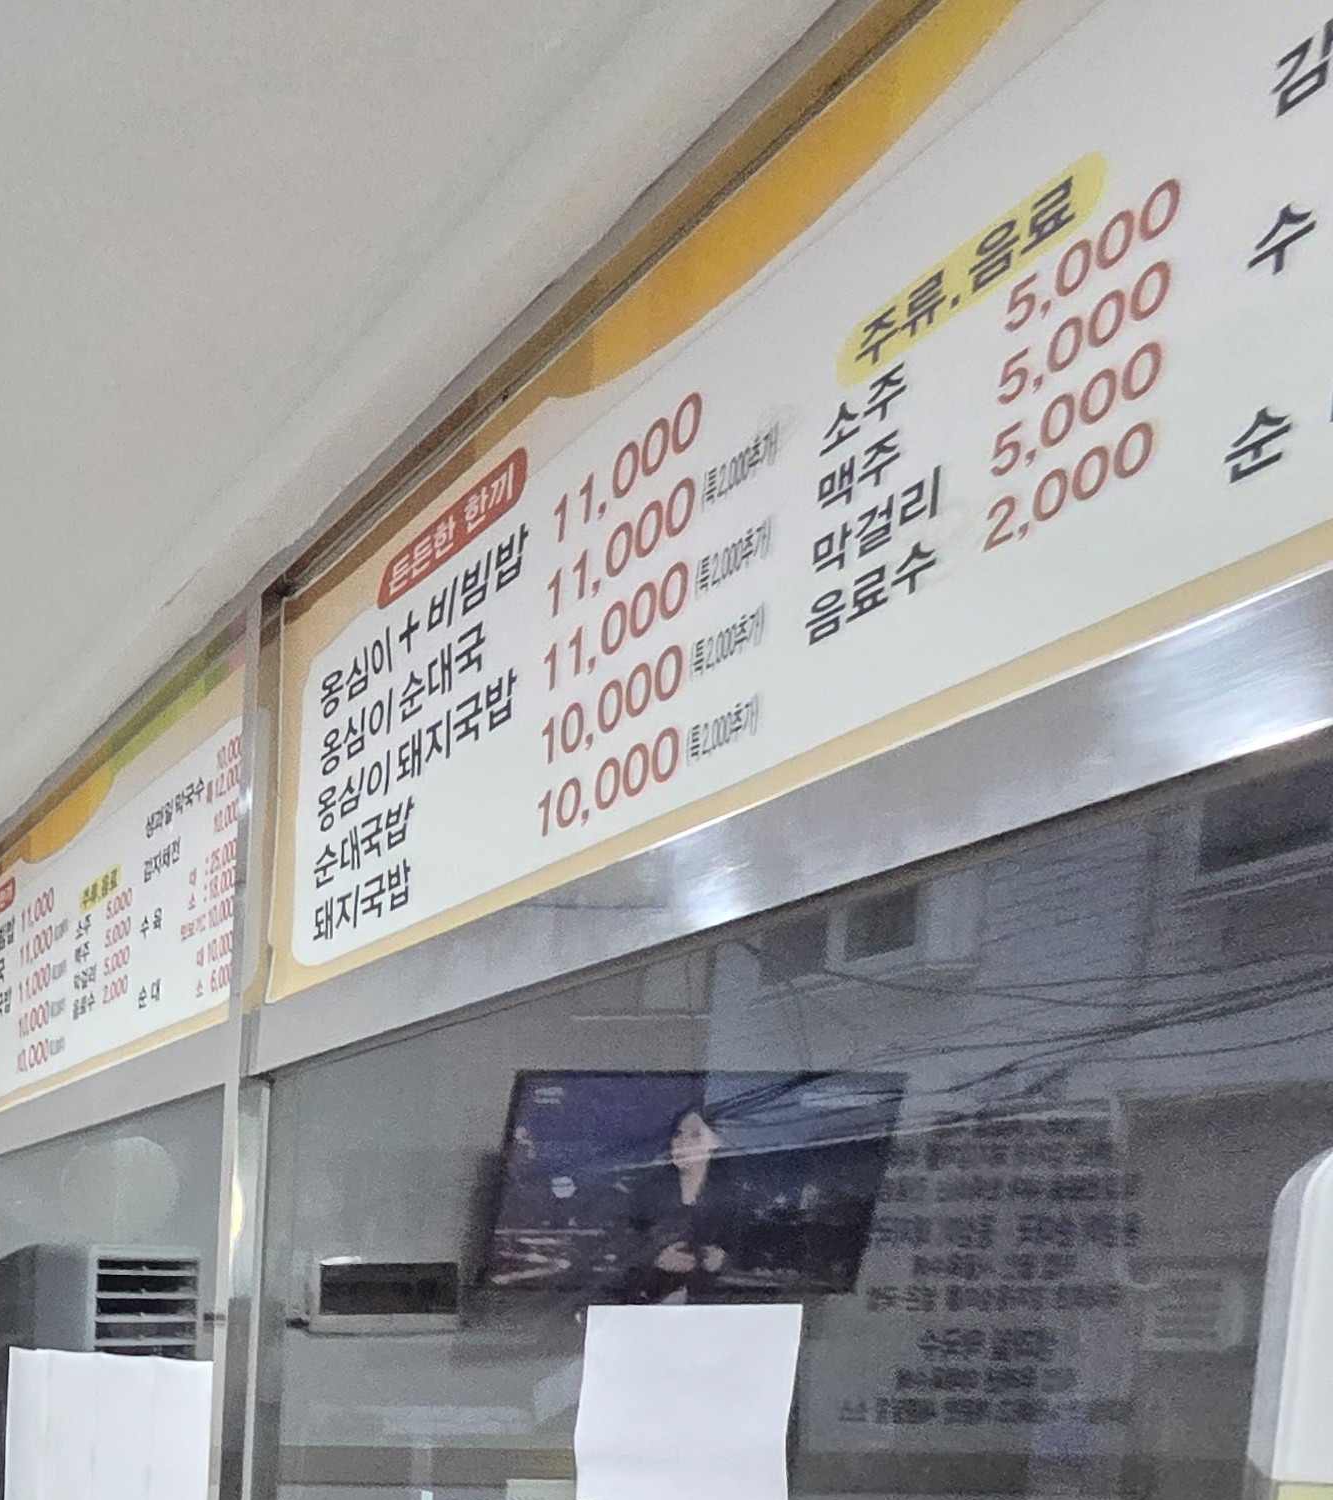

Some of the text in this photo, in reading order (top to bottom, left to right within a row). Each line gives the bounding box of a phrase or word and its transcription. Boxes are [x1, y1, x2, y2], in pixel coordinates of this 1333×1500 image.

[819, 178, 1182, 457] 소주 5,000
[968, 176, 1076, 293] 음료
[1247, 203, 1317, 276] 수
[813, 341, 1162, 574] 막걸리 5,000
[817, 260, 1172, 509] 맥주 5,000
[1225, 406, 1293, 484] 순
[321, 627, 392, 718] 옹심이
[427, 523, 529, 632] 비빔밥
[553, 392, 703, 543] 11,000
[321, 688, 392, 776] 옹심이
[399, 621, 487, 723] 순대국
[548, 477, 696, 618] 11,000
[389, 463, 514, 596] 든든한 한끼
[805, 422, 1154, 646] 음료수 2,000
[313, 796, 415, 889] 순대국밥
[542, 645, 683, 764] 10,000
[317, 750, 391, 832] 옹심이
[397, 667, 518, 782] 돼지국밥
[544, 561, 688, 691] 11,000
[105, 916, 131, 948] 5,000
[106, 887, 133, 920] 5,000
[313, 858, 411, 941] 돼지국밥
[538, 727, 680, 837] 10,000
[103, 945, 130, 976] 5,000
